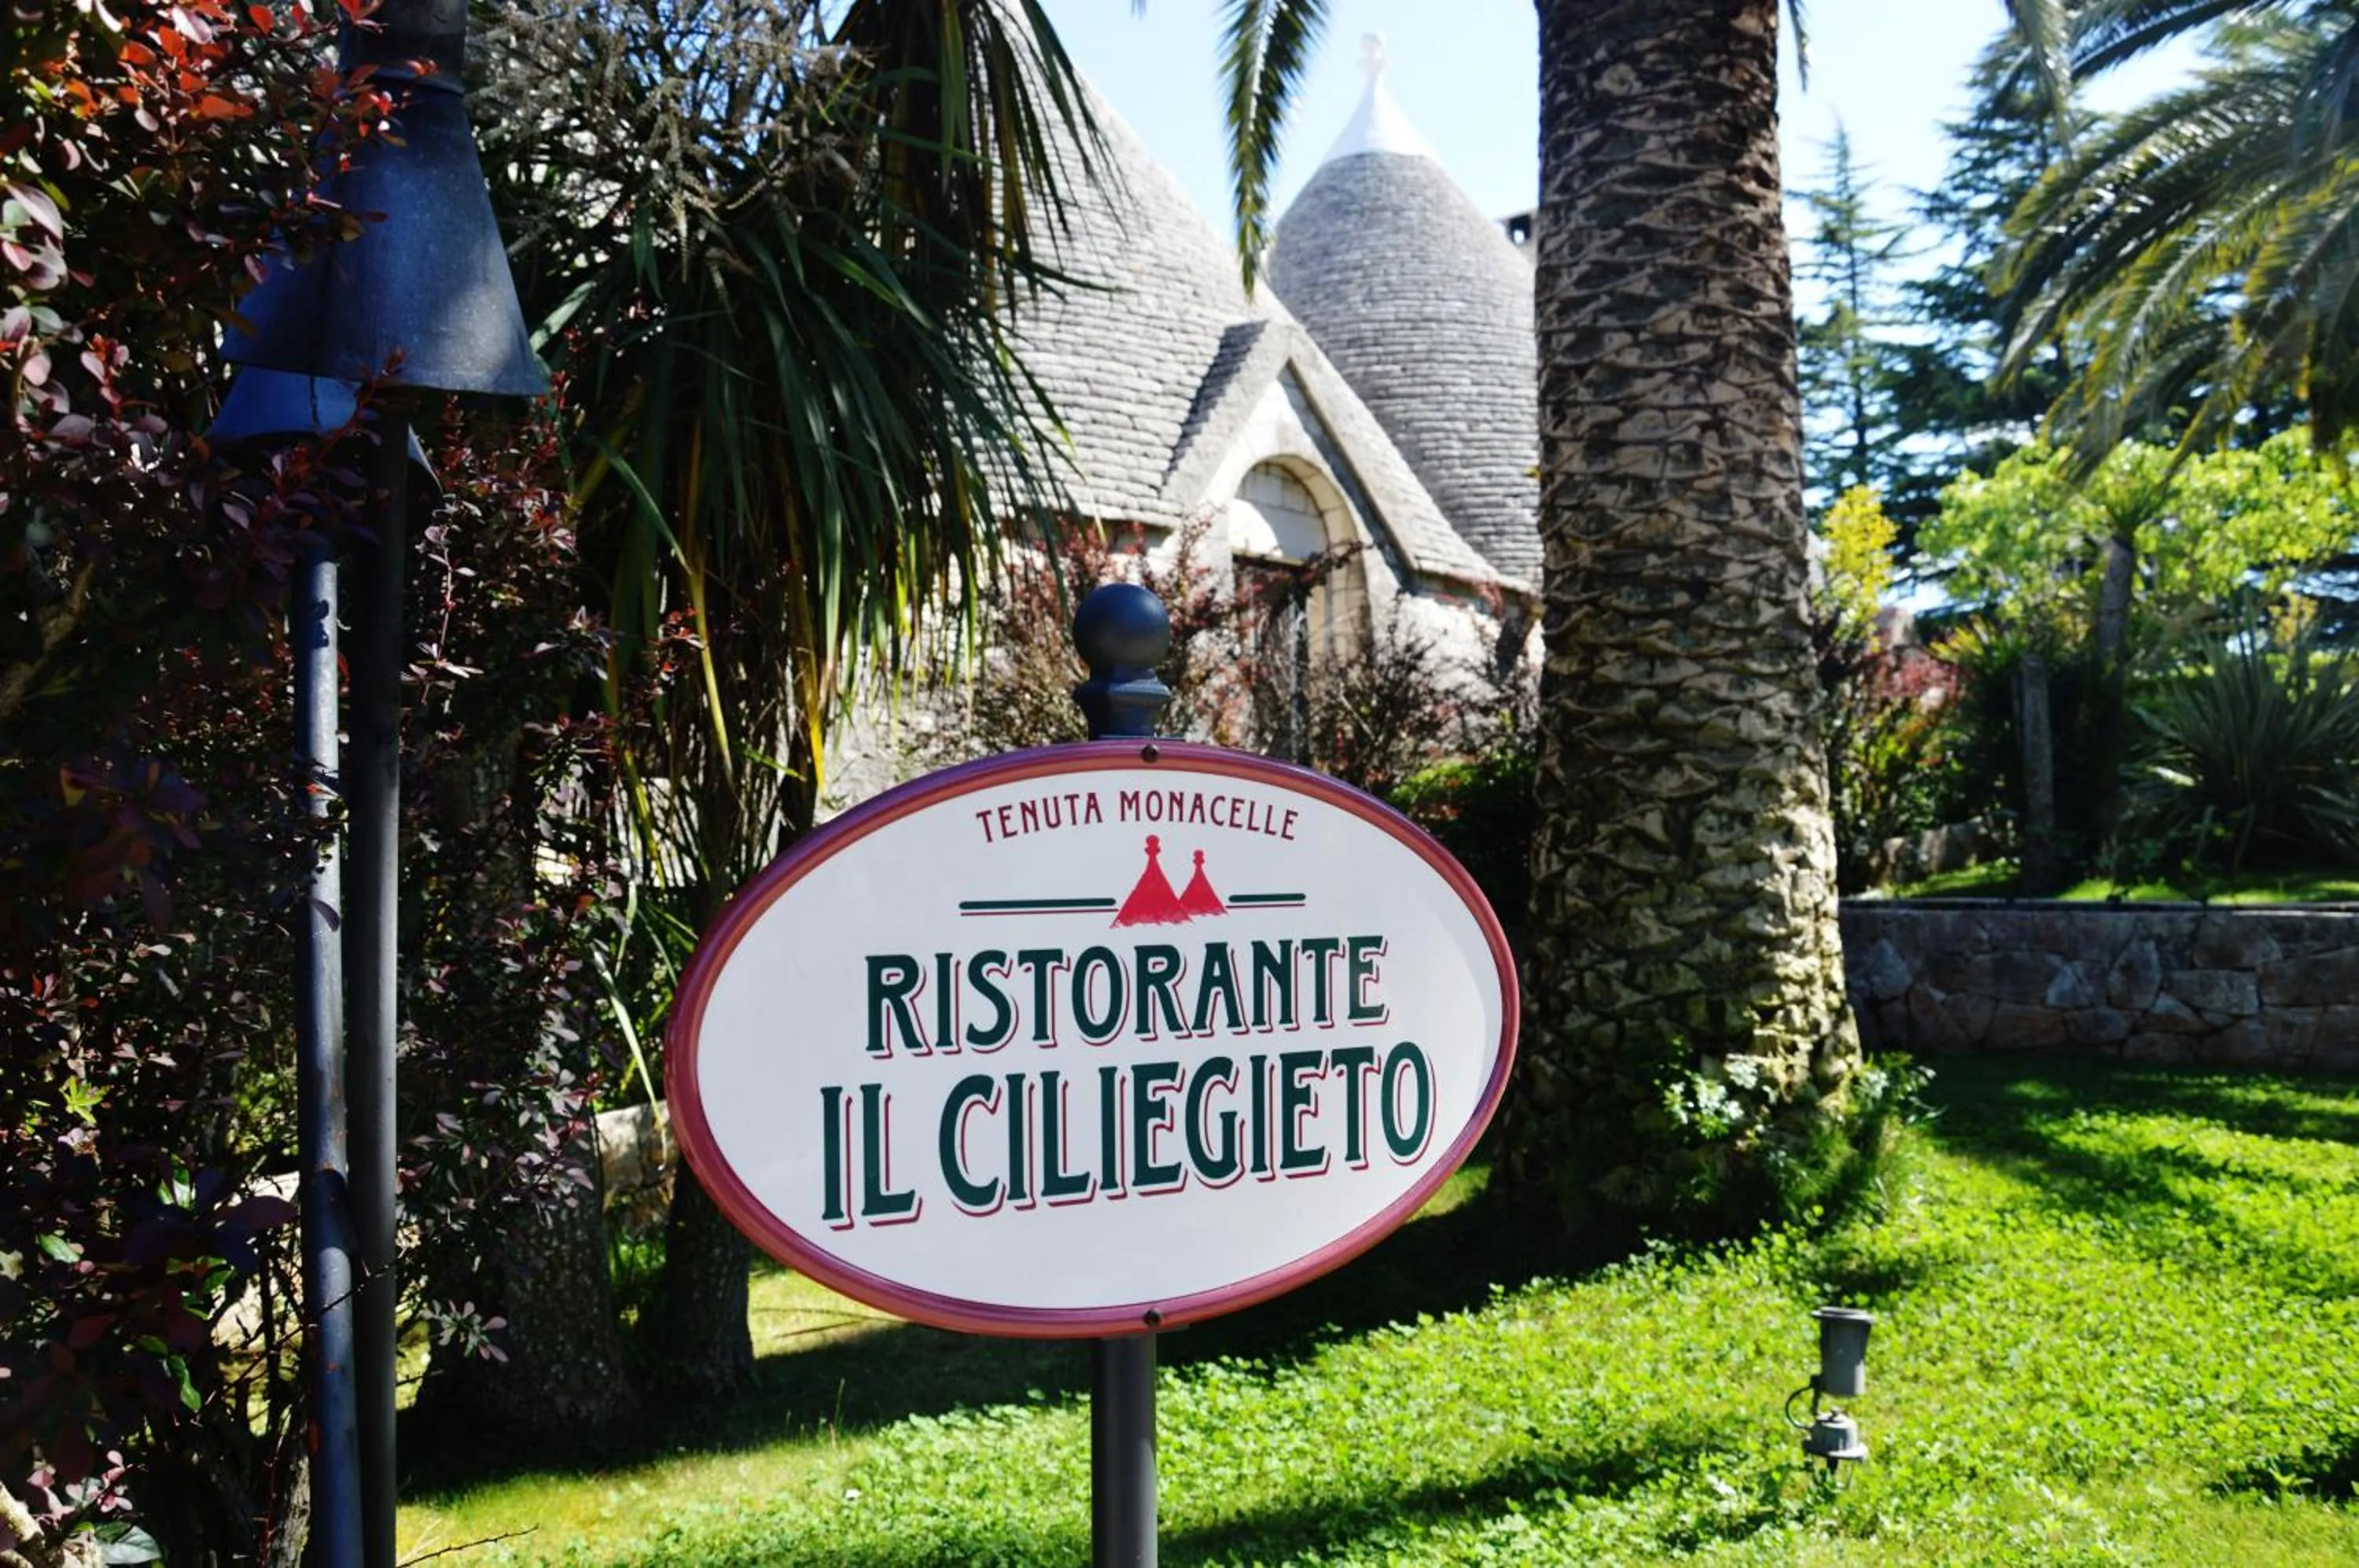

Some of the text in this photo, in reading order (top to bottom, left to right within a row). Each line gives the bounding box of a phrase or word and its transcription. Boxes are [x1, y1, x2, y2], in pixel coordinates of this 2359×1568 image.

[976, 790, 1299, 843] TENUTA MONACELLE
[865, 935, 1389, 1059] RISTORANTE
[820, 1040, 1437, 1231] IL CILIEGIETO
